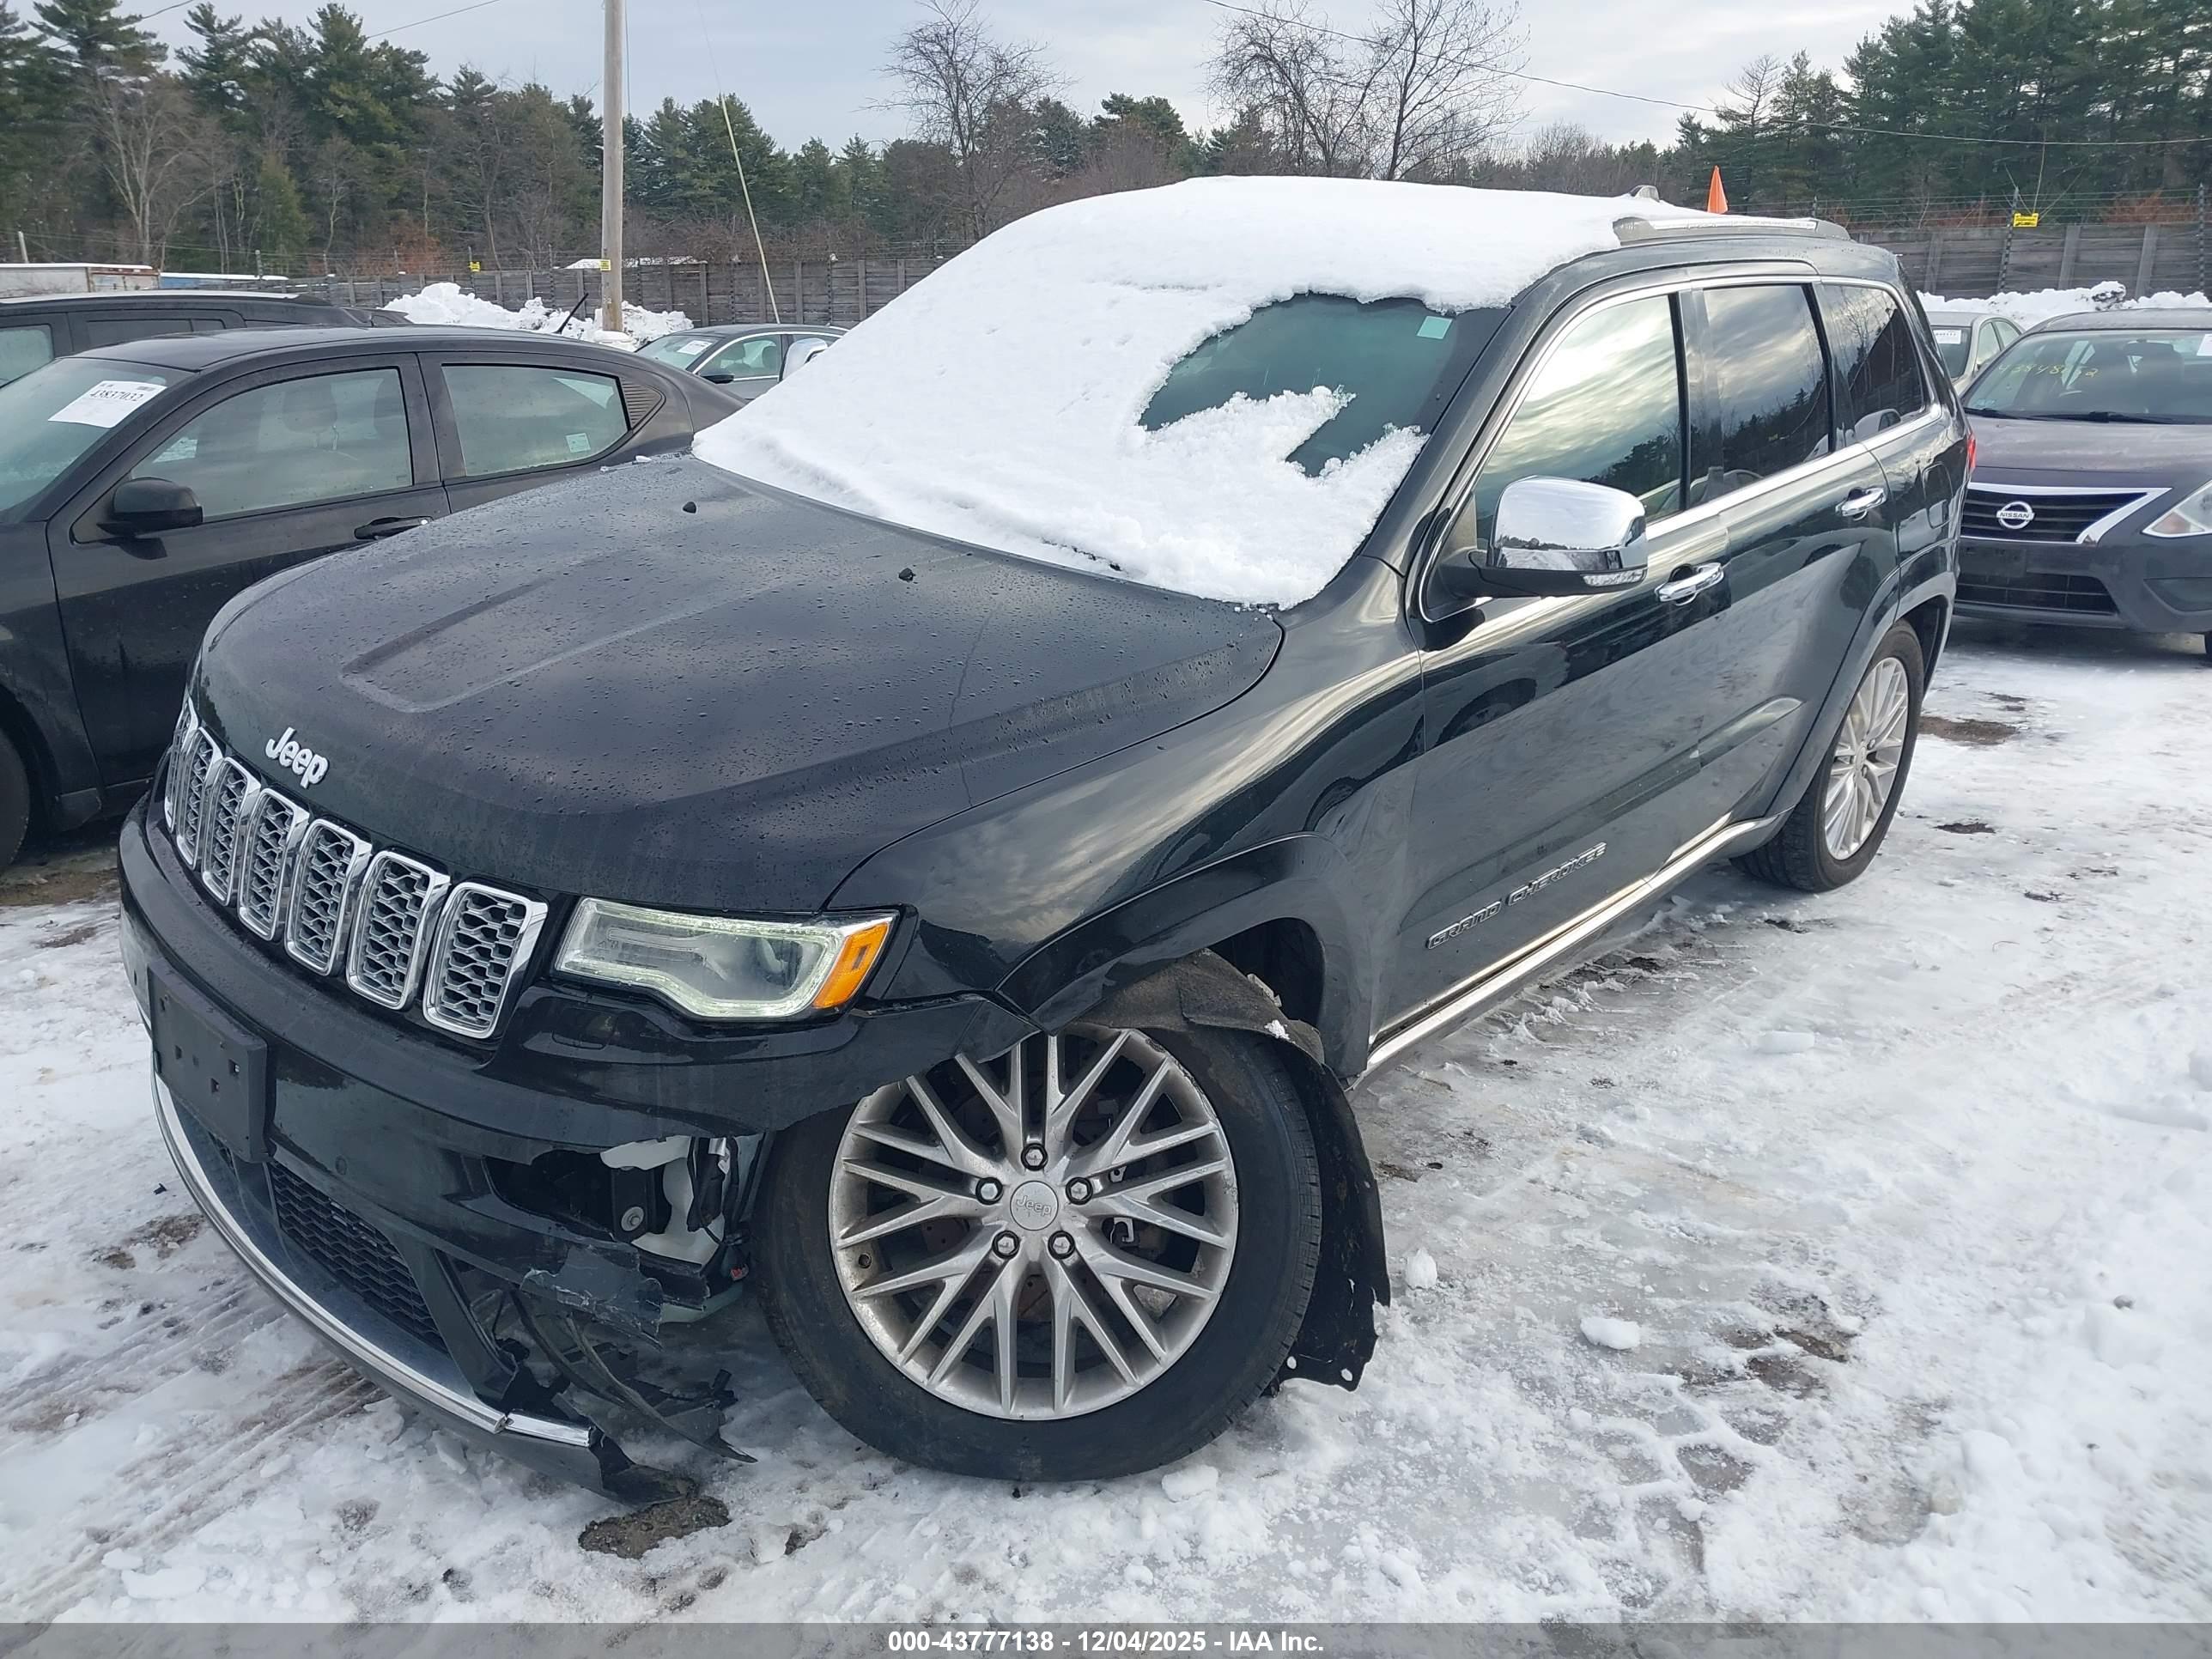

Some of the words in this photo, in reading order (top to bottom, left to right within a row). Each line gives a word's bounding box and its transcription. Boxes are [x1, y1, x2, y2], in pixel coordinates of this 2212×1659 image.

[265, 726, 329, 789] Jeep
[1427, 901, 1502, 950] GRAND
[1508, 842, 1607, 906] CHEROKEE
[1016, 1195, 1052, 1217] Jeep
